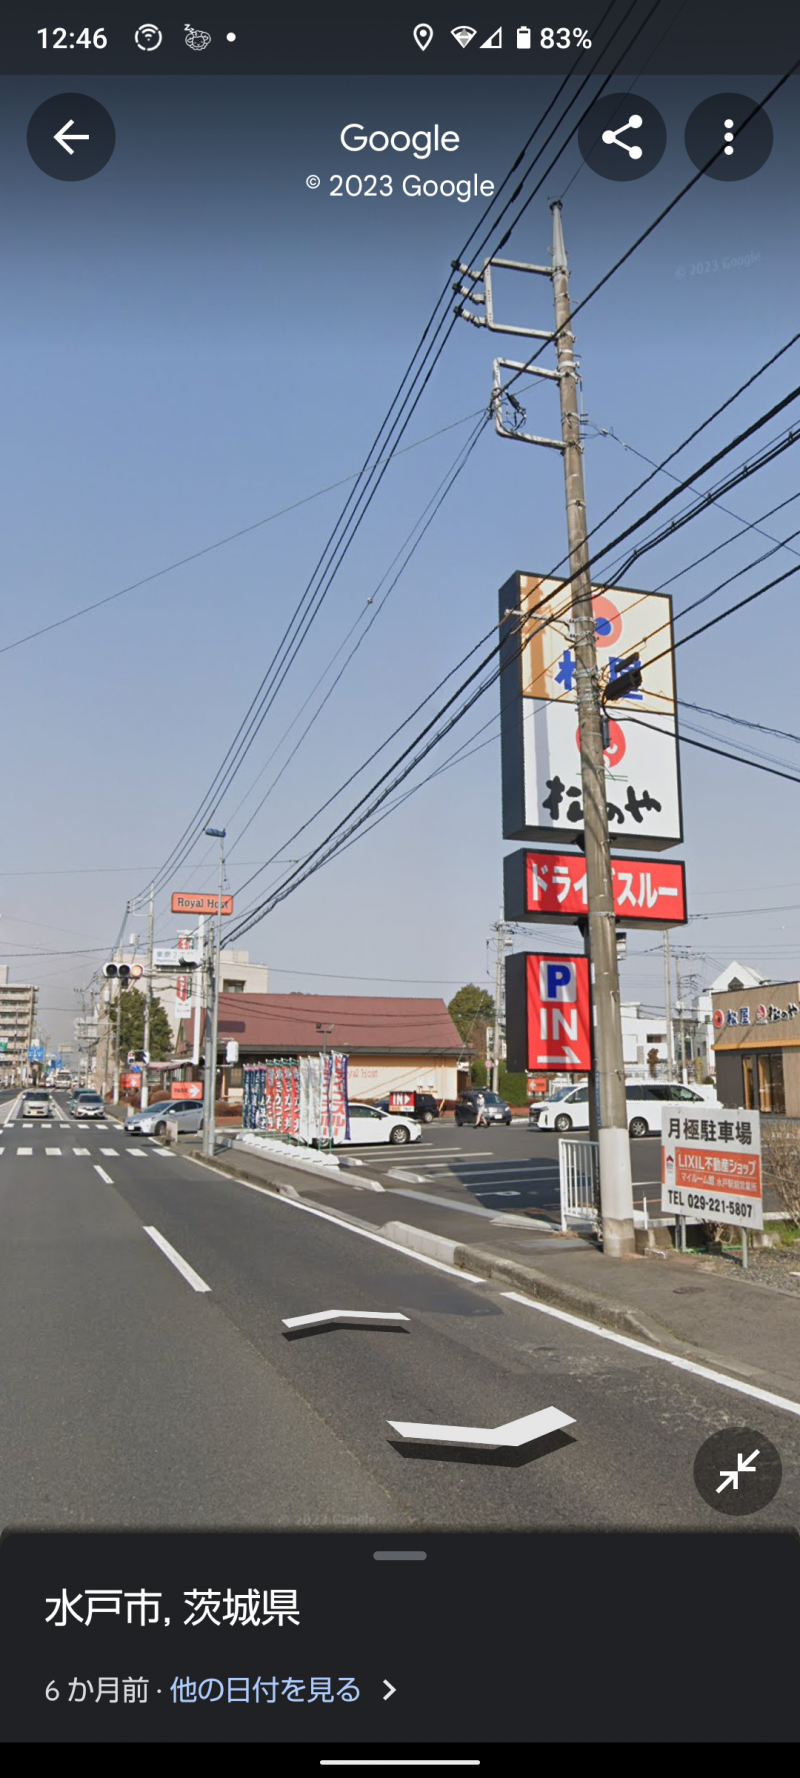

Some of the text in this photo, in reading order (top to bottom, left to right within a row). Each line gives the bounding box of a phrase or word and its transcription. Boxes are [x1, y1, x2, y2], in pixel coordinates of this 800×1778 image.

[532, 863, 679, 909] ドライスルー
[177, 897, 229, 909] Royal Host
[546, 964, 571, 999] P
[540, 1008, 578, 1041] IN
[726, 1006, 751, 1027] 松屋
[393, 1093, 403, 1105] IN
[668, 1118, 752, 1146] 月極駐車場
[668, 1190, 753, 1218] TEL 029-221-5807
